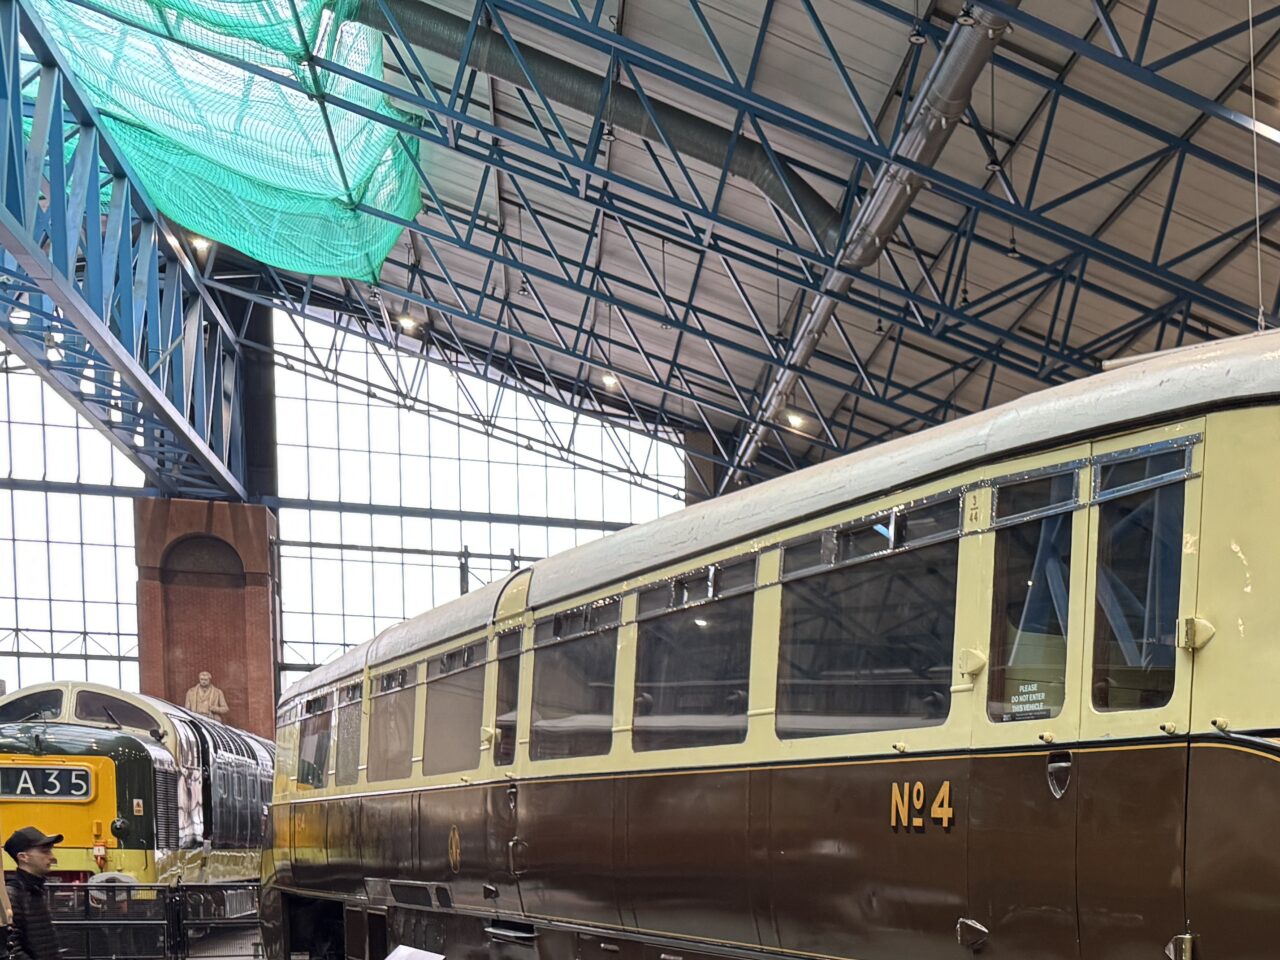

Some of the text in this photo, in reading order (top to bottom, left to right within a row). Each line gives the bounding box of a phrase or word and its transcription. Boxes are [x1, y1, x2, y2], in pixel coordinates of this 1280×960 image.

[1019, 683, 1038, 692] PLEASE
[1011, 692, 1045, 703] DO NOT ENTER
[1012, 702, 1044, 712] THIS VEHICLE
